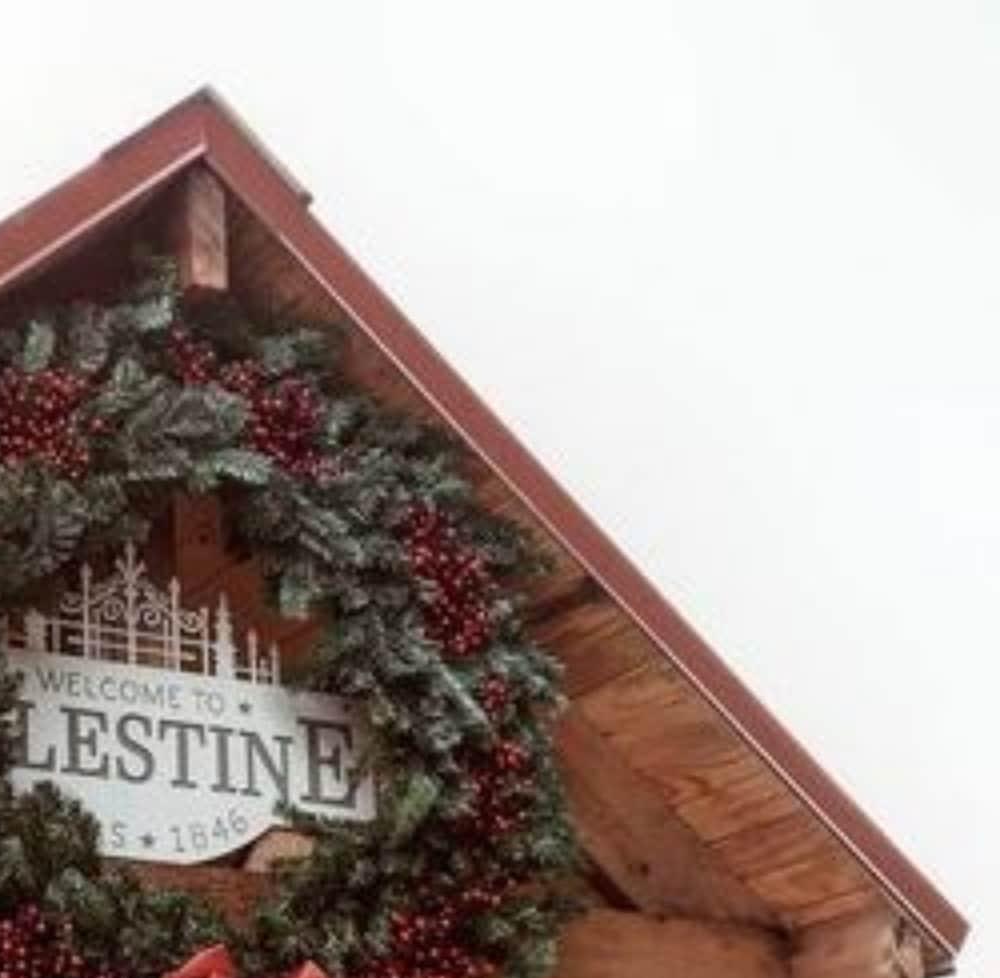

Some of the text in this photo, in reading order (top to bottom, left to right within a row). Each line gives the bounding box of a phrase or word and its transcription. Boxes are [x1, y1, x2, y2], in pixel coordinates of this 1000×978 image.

[36, 669, 226, 714] WELCOME TO
[10, 701, 356, 809] LESTINE
[168, 806, 249, 853] 1846
